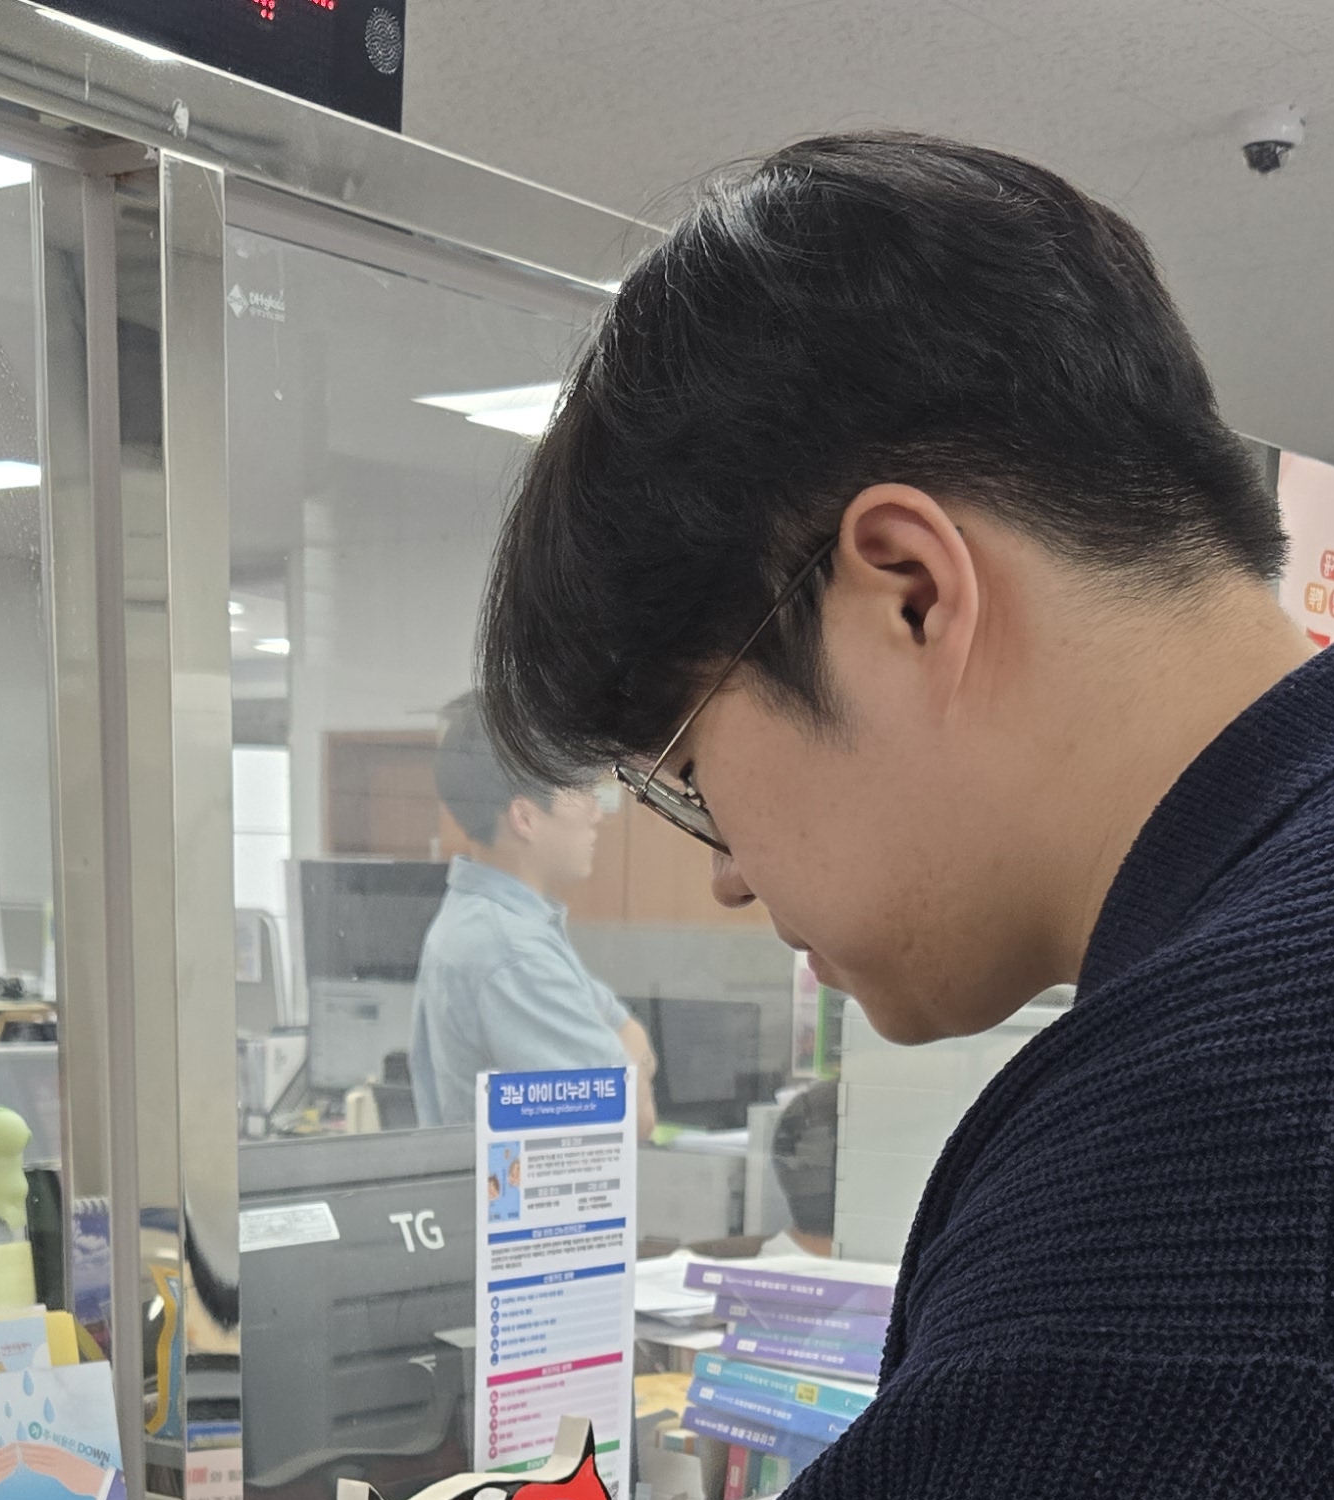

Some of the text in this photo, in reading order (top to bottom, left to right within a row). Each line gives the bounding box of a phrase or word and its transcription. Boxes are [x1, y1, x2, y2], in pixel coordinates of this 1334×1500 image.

[500, 1080, 616, 1105] 경남 아이 다누리 카드
[390, 1211, 444, 1256] TG
